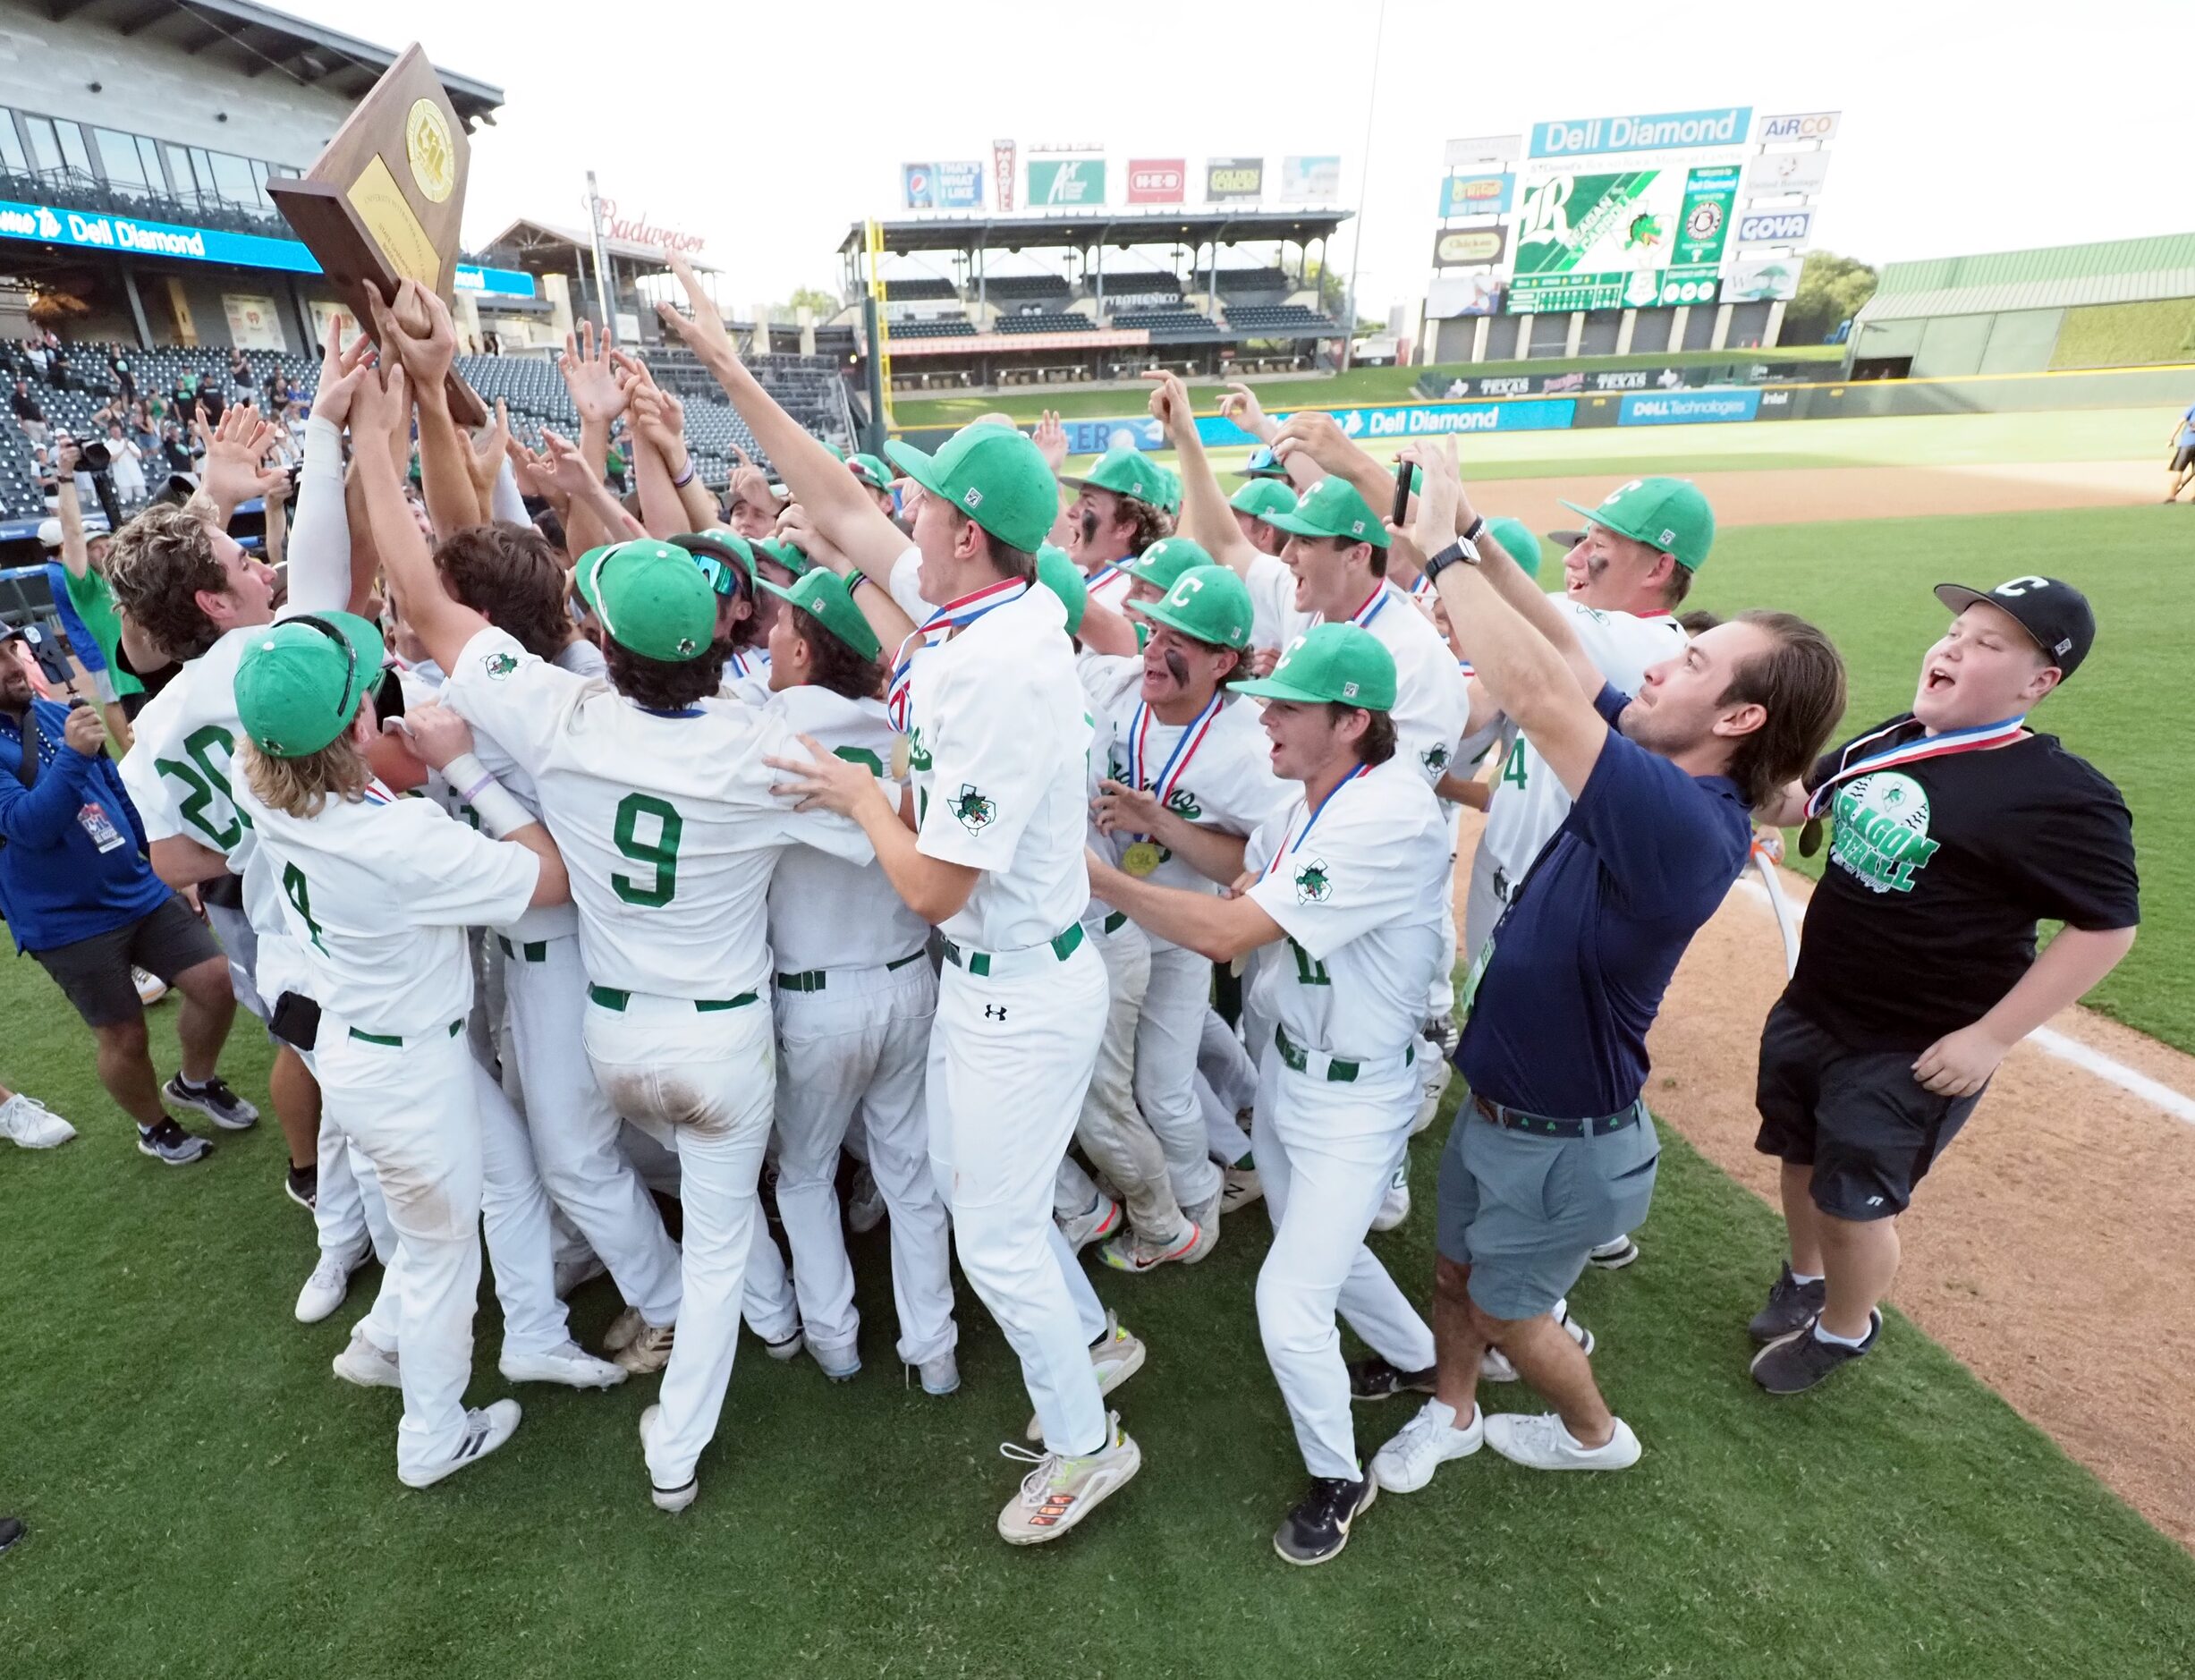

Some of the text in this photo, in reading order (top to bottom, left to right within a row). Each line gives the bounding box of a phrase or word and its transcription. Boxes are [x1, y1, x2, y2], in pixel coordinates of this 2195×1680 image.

[1545, 120, 1604, 153] Dell
[1609, 109, 1738, 148] Diamond
[941, 174, 976, 187] WHAT
[948, 186, 975, 199] LIKE
[67, 214, 114, 246] Dell
[114, 221, 206, 257] Diamond
[582, 194, 706, 253] Budweiser
[1481, 381, 1530, 395] TEXAS
[1598, 375, 1647, 389] TEXAS
[1370, 411, 1406, 435] Dell
[1409, 406, 1500, 432] Diamond
[1632, 399, 1745, 417] DELL Technologies
[1140, 542, 1166, 565] C
[1170, 577, 1205, 608] C
[1996, 575, 2049, 598] C
[1275, 635, 1308, 670] C
[153, 724, 255, 852] 20
[610, 791, 683, 909] 9
